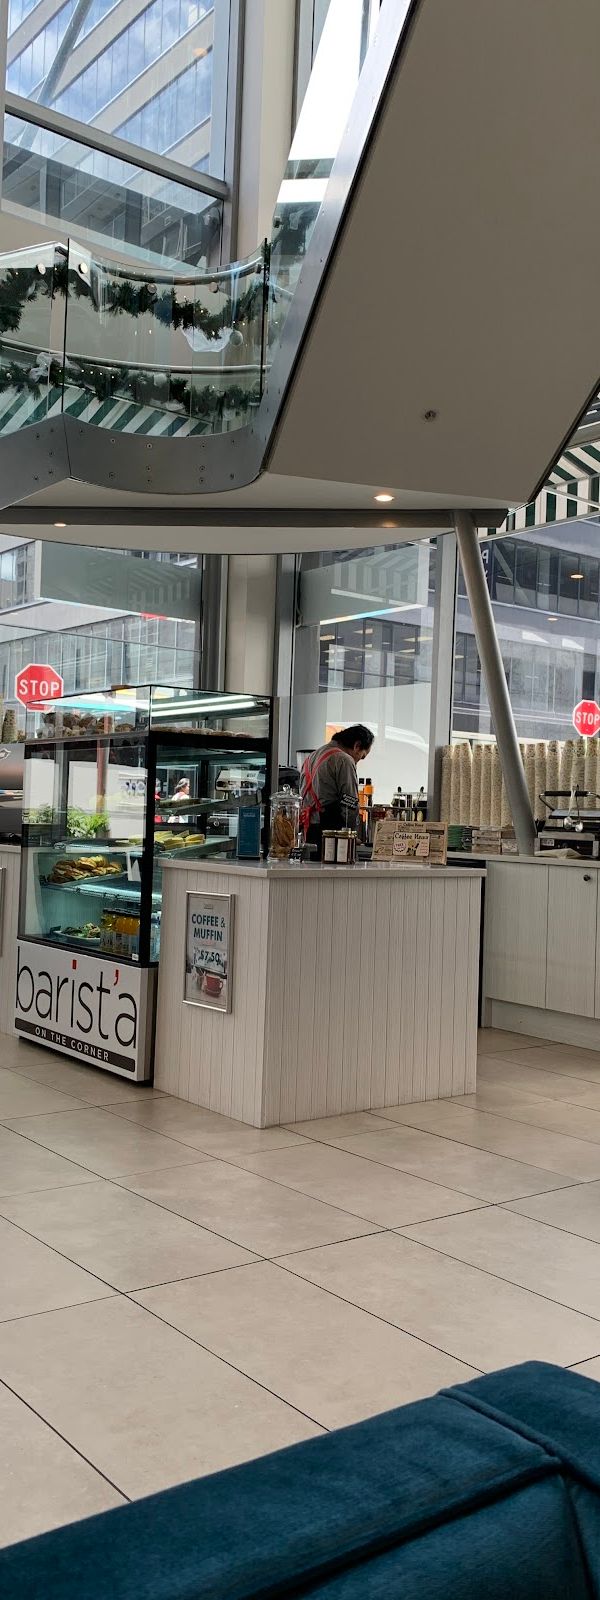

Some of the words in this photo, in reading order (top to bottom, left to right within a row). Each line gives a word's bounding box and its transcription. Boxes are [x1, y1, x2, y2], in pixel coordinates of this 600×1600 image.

[19, 679, 60, 697] STOP
[576, 712, 600, 726] STOP
[191, 913, 219, 927] COFFEE
[220, 917, 226, 928] &
[193, 927, 223, 942] MUFFIN
[35, 1026, 47, 1038] ON
[50, 1032, 66, 1046] THE
[70, 1040, 109, 1062] CORNER
